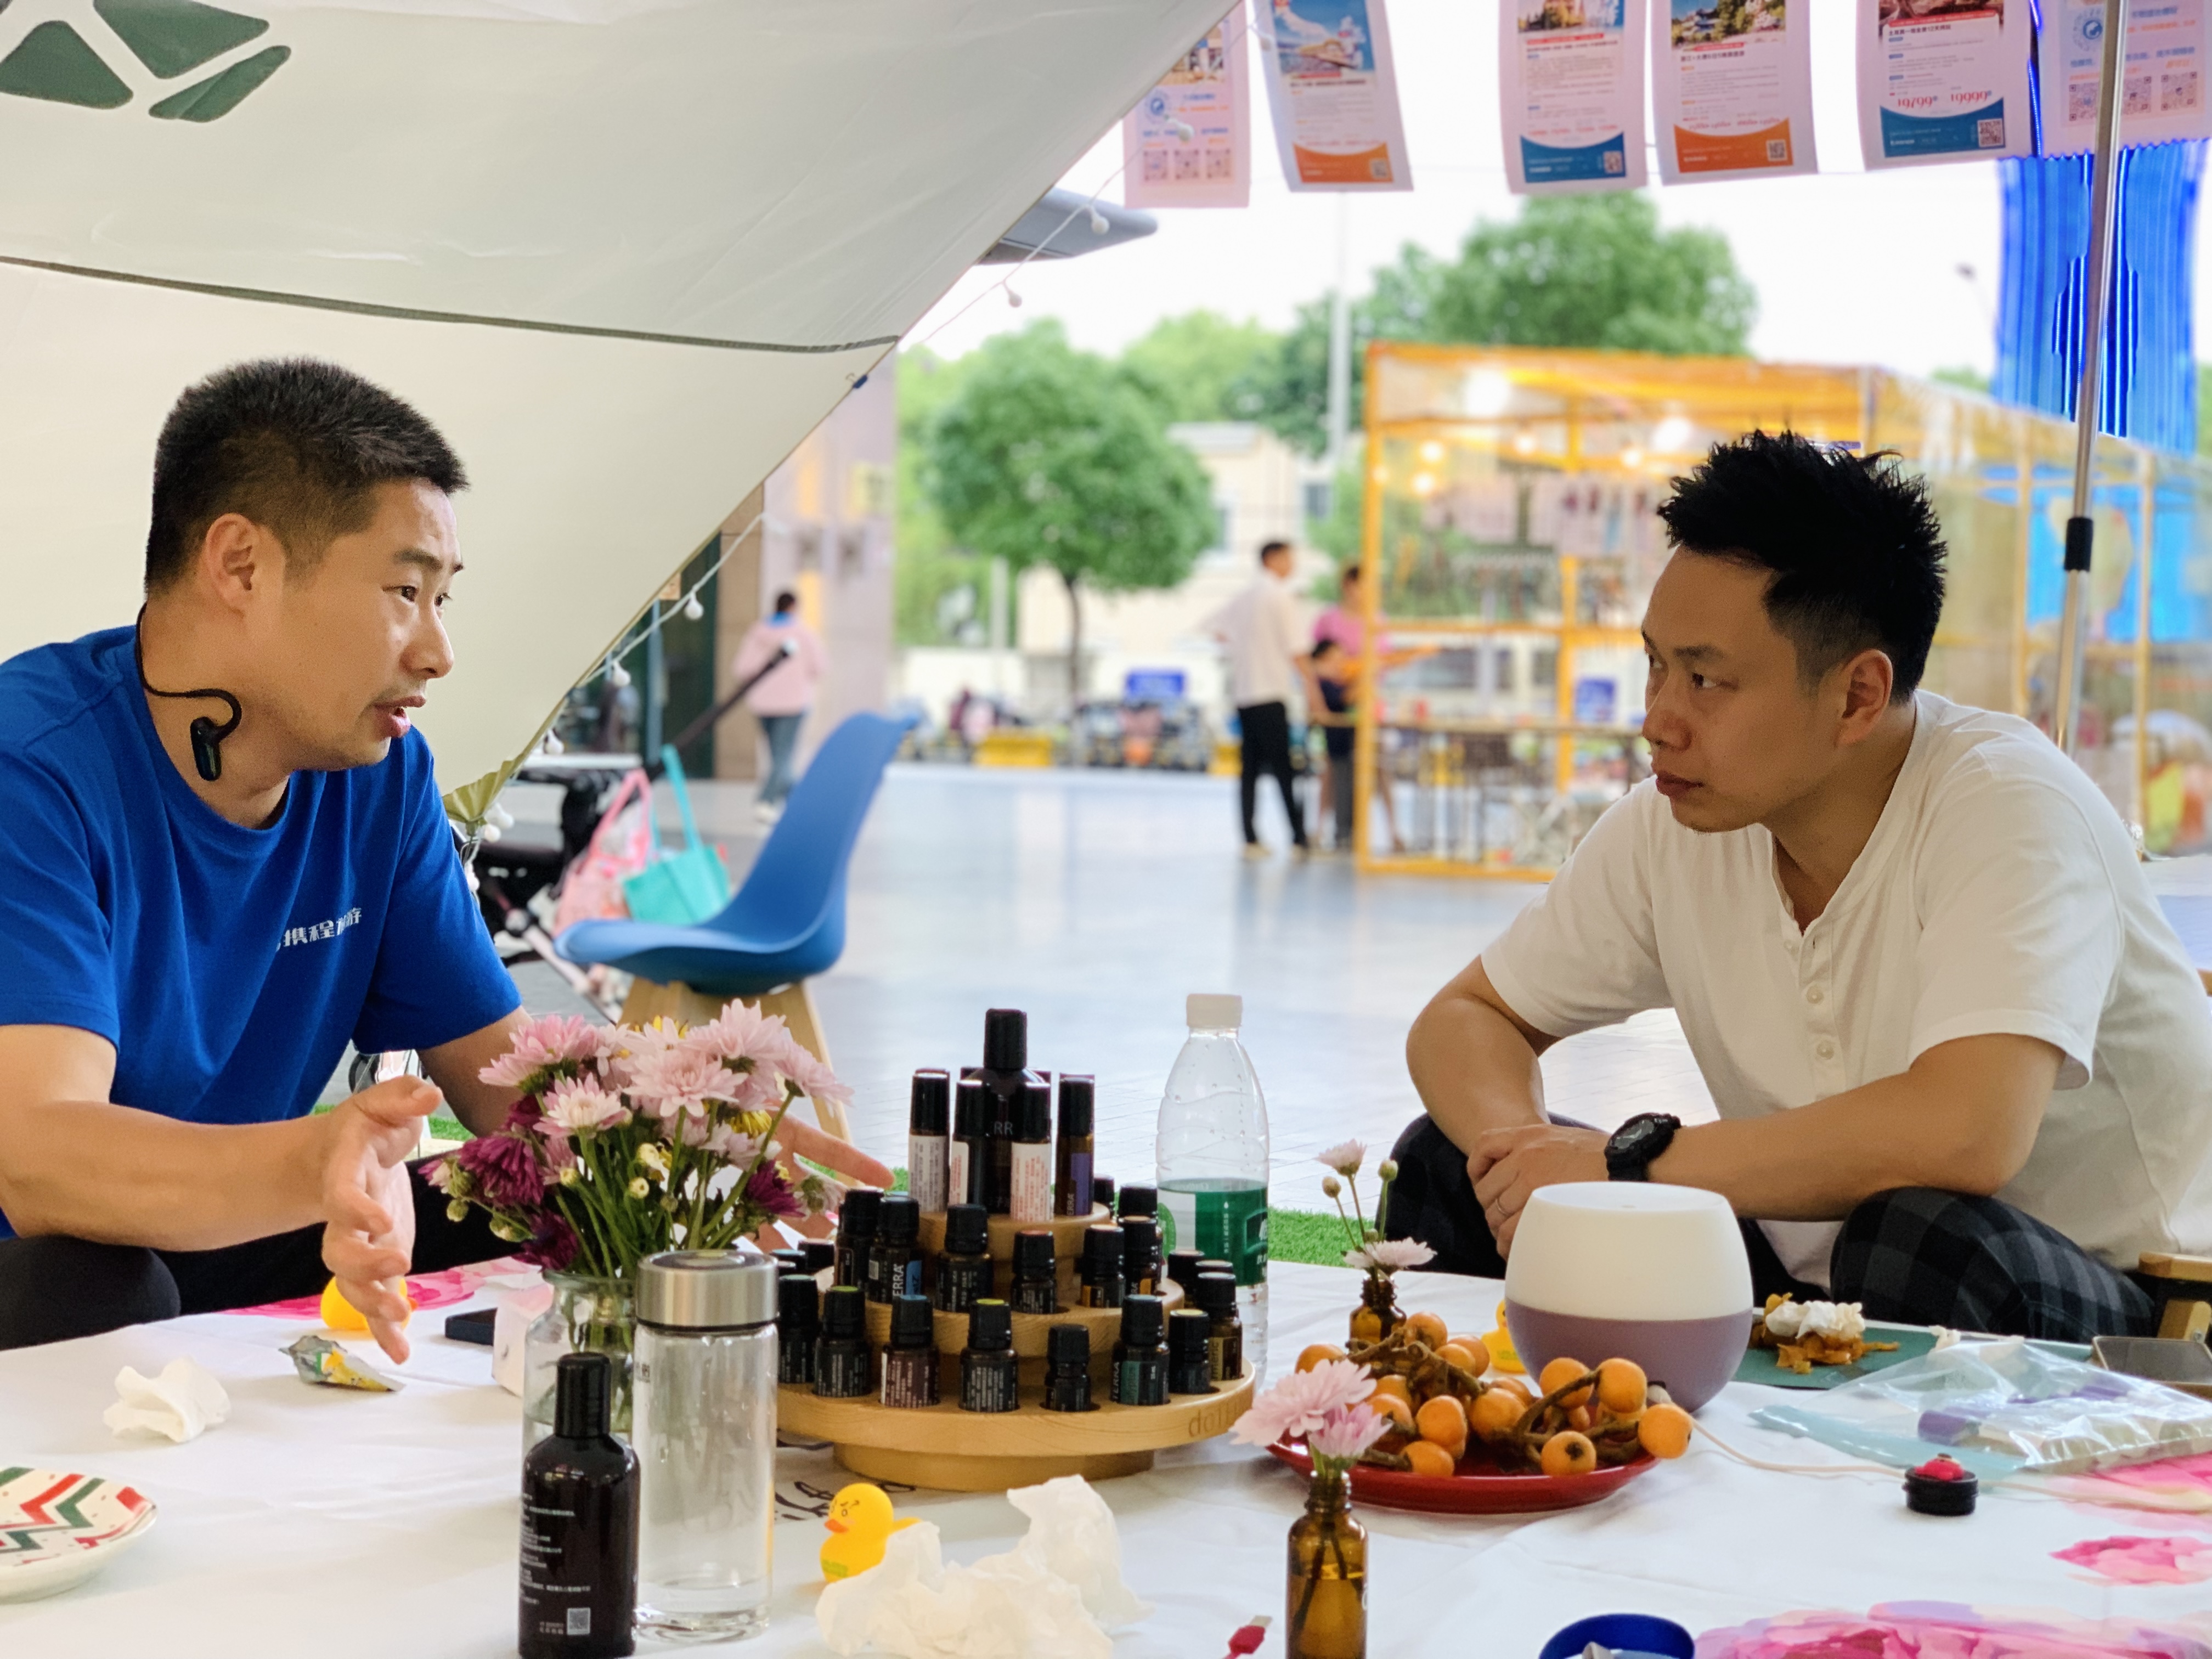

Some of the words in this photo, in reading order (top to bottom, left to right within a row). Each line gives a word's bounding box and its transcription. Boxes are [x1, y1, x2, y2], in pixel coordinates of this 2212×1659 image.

[994, 1121, 1013, 1136] RR
[1066, 1193, 1075, 1216] ERRA
[892, 1263, 905, 1297] ERRA
